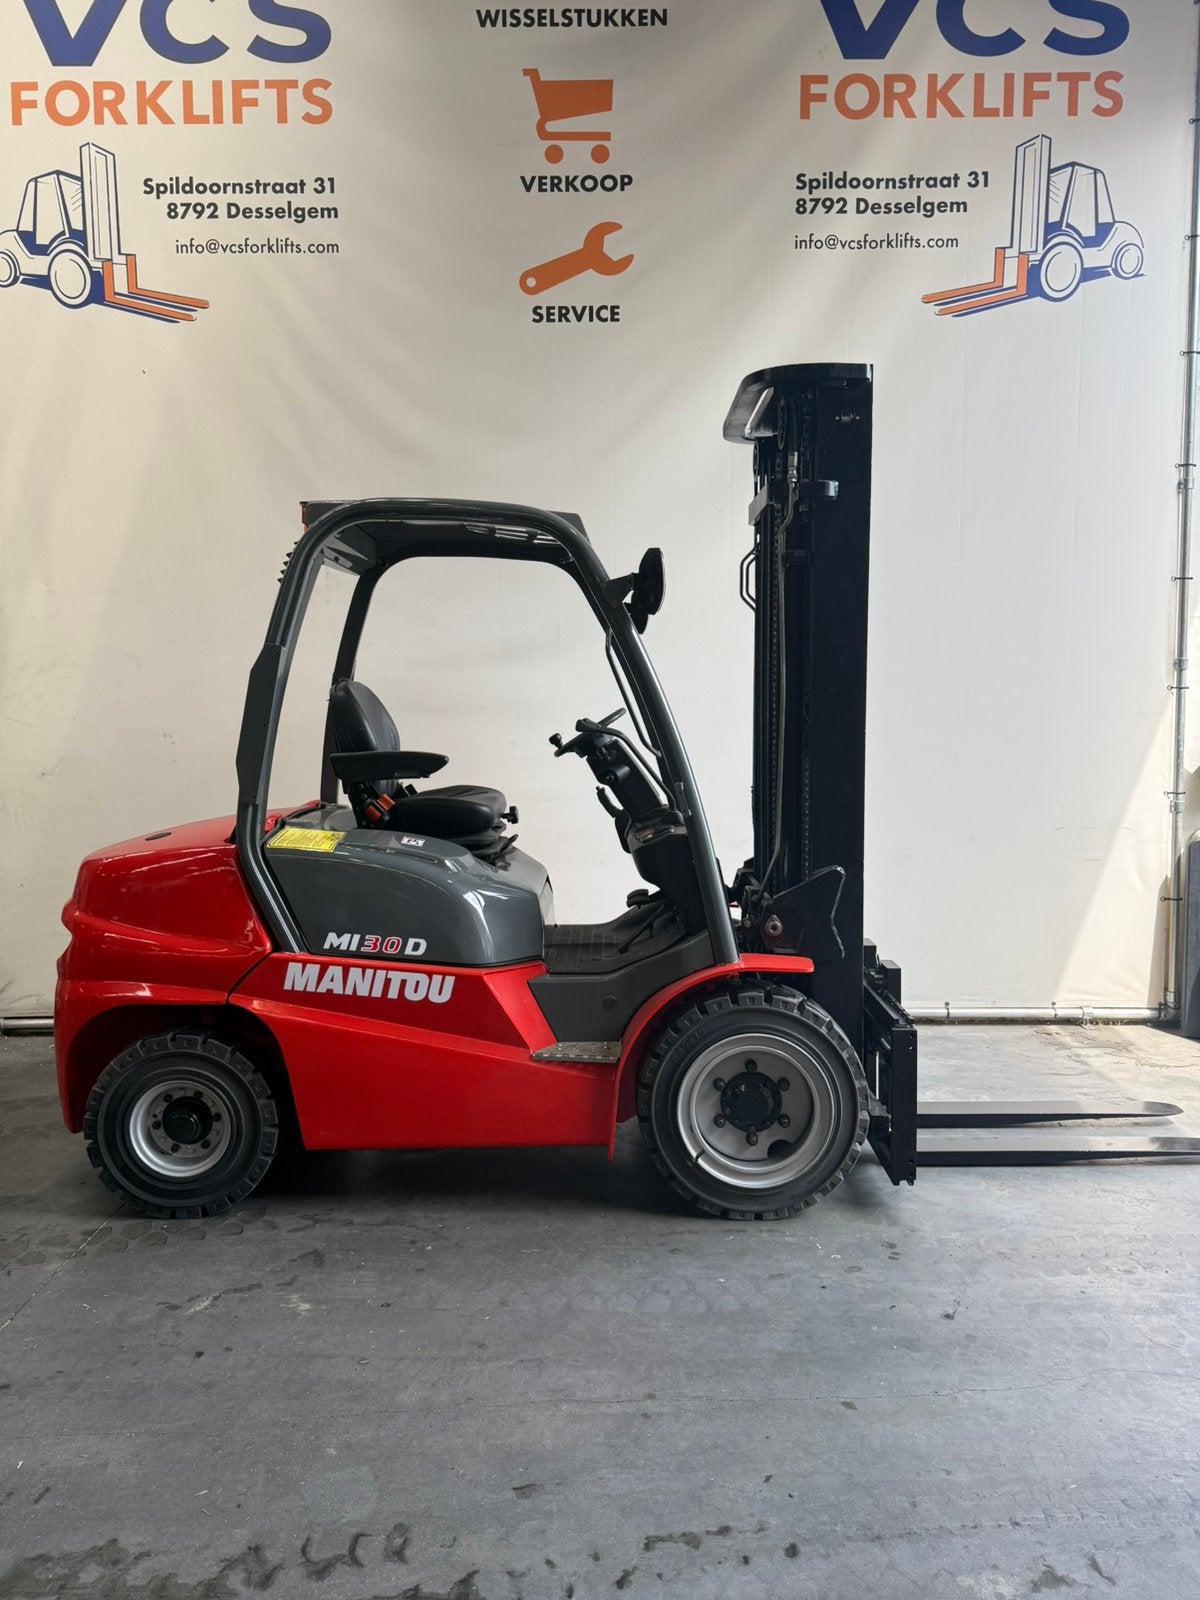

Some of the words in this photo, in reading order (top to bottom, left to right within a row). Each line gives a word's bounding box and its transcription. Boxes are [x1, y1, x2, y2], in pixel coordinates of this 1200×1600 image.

[475, 8, 668, 28] WISSELSTUKKEN
[24, 0, 332, 67] VCS
[821, 0, 1130, 60] VCS
[10, 78, 333, 126] FORKLIFTS
[799, 70, 1124, 120] FORKLIFTS
[142, 176, 306, 199] Spildoornstraat
[313, 176, 336, 194] 31
[520, 174, 633, 193] VERKOOP
[795, 171, 961, 194] Spildoornstraat
[967, 171, 990, 188] 31
[166, 202, 219, 219] 8792
[226, 201, 339, 223] Desselgem
[795, 197, 848, 215] 8792
[855, 196, 968, 217] Desselgem
[175, 237, 340, 254] info@vcsforklifts.com
[794, 232, 959, 250] info@vcsforklifts.com
[531, 305, 621, 323] SERVICE
[283, 962, 456, 1004] MANITOU
